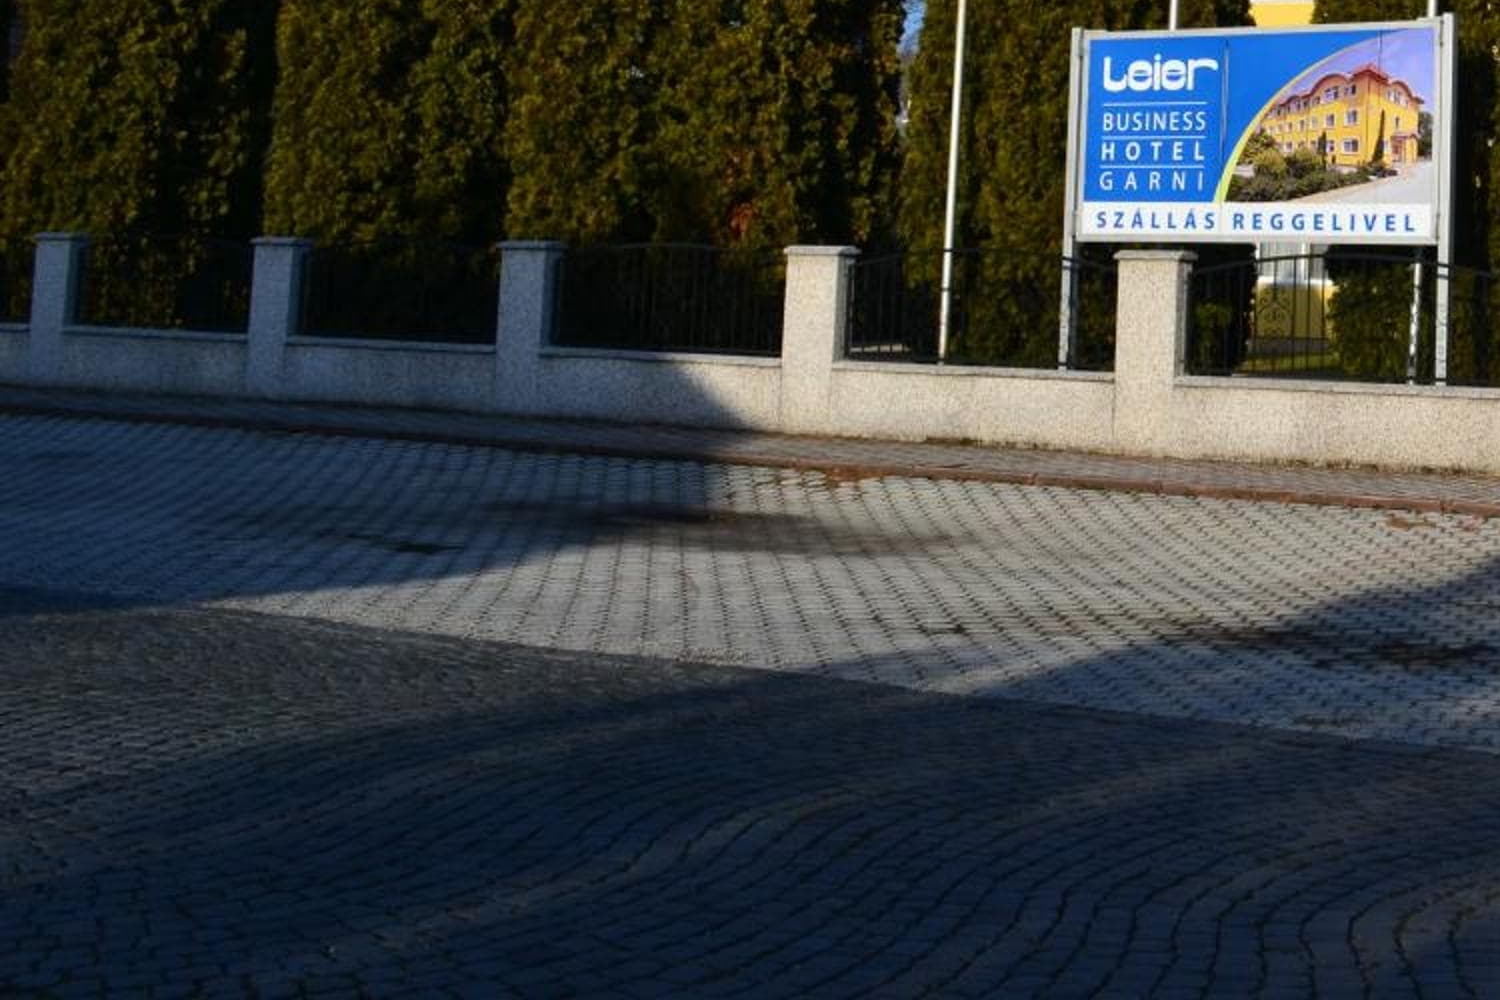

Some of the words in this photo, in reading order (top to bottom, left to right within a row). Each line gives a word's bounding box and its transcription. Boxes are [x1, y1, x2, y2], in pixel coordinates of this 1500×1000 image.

[1103, 53, 1219, 92] Leier
[1102, 110, 1206, 132] BUSINESS
[1101, 140, 1205, 161] HOTEL
[1099, 170, 1204, 192] GARNI
[1096, 209, 1215, 230] SZÁLLÁS
[1232, 212, 1416, 232] REGGELIVEL
